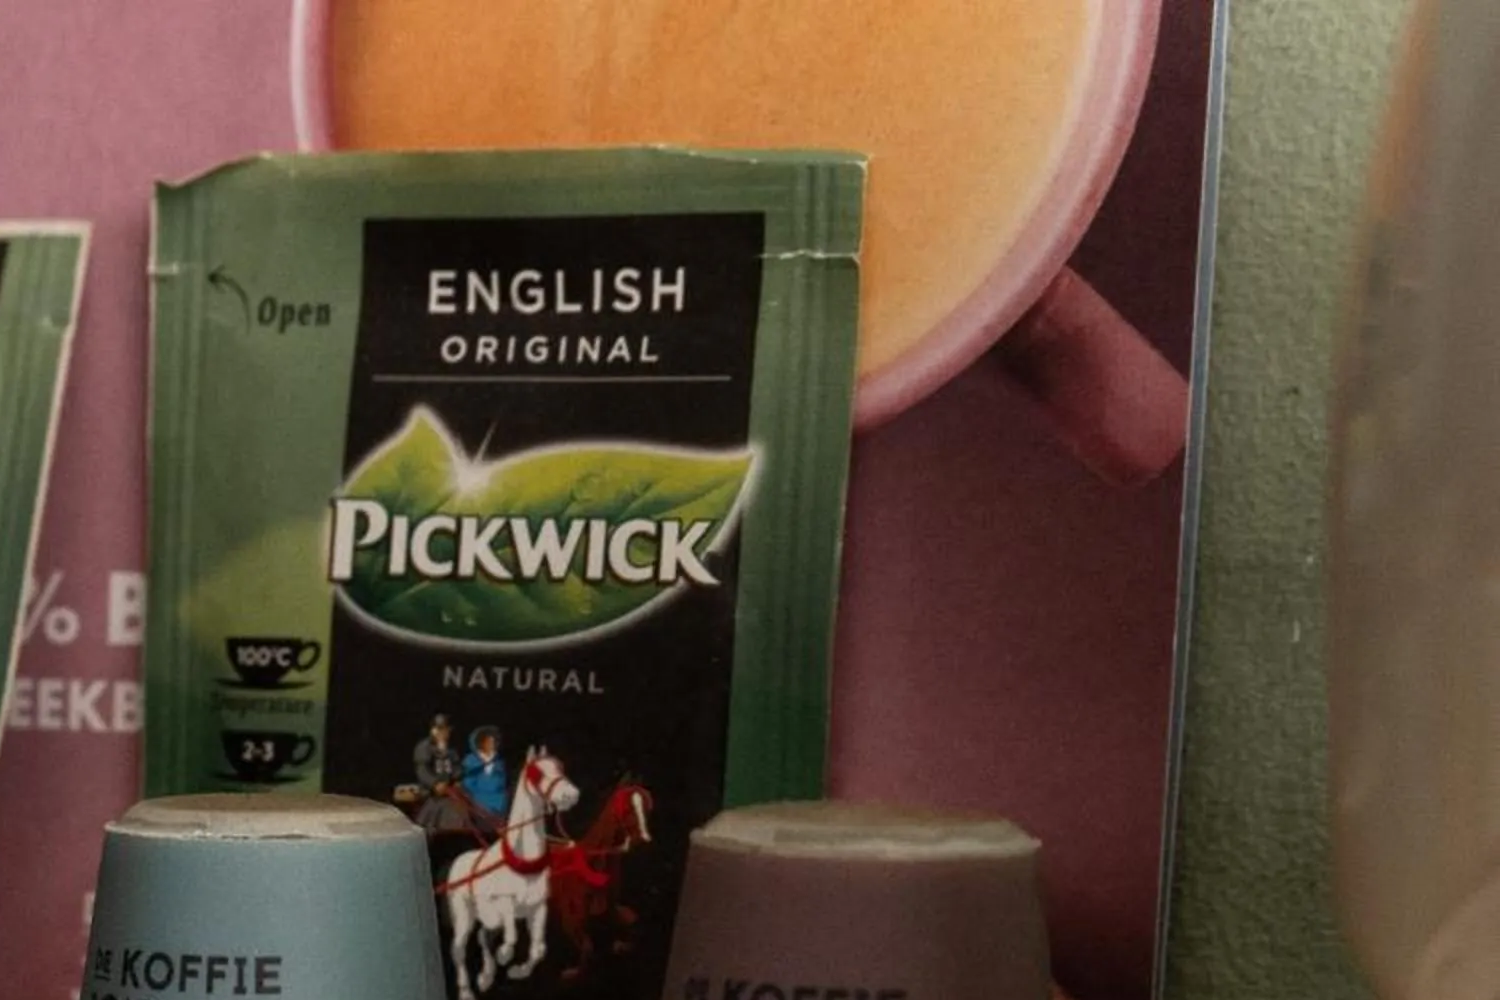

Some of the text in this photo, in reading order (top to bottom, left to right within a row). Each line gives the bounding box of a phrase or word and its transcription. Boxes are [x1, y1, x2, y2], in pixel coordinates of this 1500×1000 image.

[426, 266, 687, 315] ENGLISH
[256, 295, 332, 335] Open
[440, 335, 660, 364] ORIGINAL
[328, 497, 721, 586] PICKWICK
[443, 665, 605, 695] NATURAL
[119, 949, 283, 995] KOFFIE
